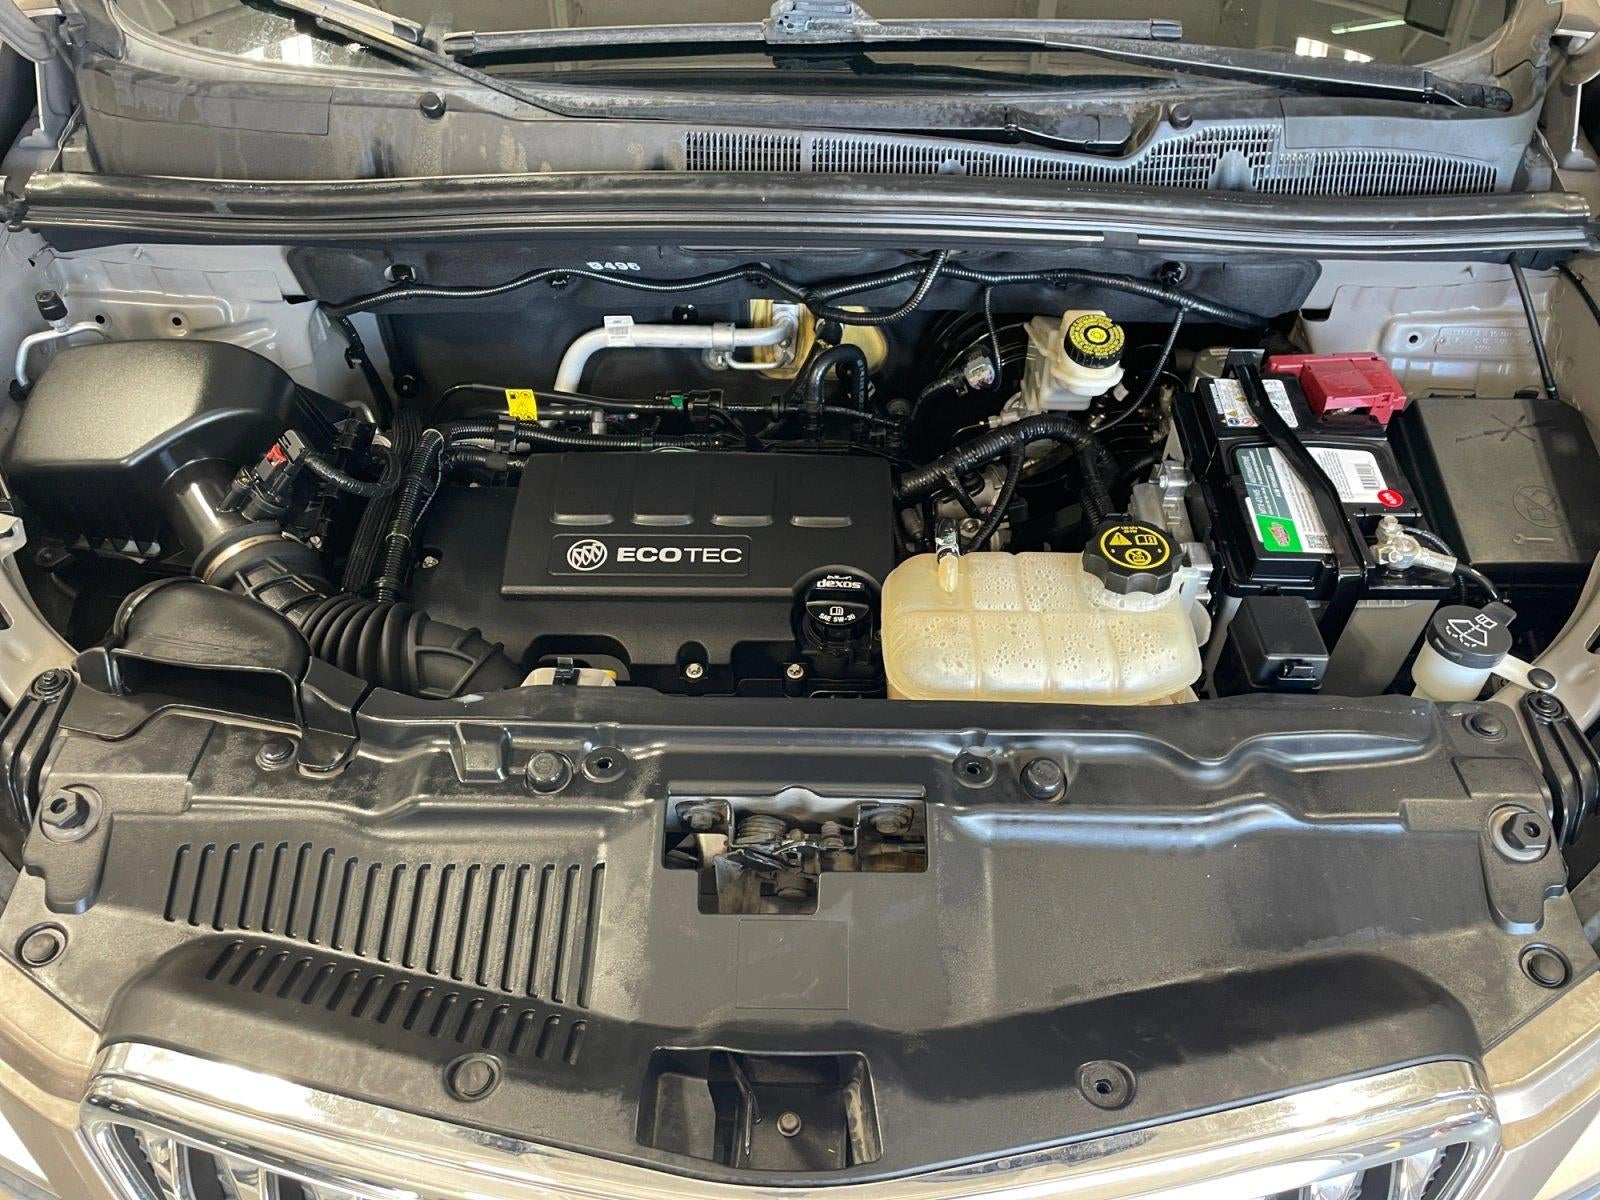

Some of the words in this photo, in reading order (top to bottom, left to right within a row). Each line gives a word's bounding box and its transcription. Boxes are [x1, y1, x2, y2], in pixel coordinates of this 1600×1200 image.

[616, 546, 743, 564] ECOTEC
[816, 578, 863, 589] dexos
[818, 612, 832, 622] SAE
[833, 613, 856, 623] 5W-30
